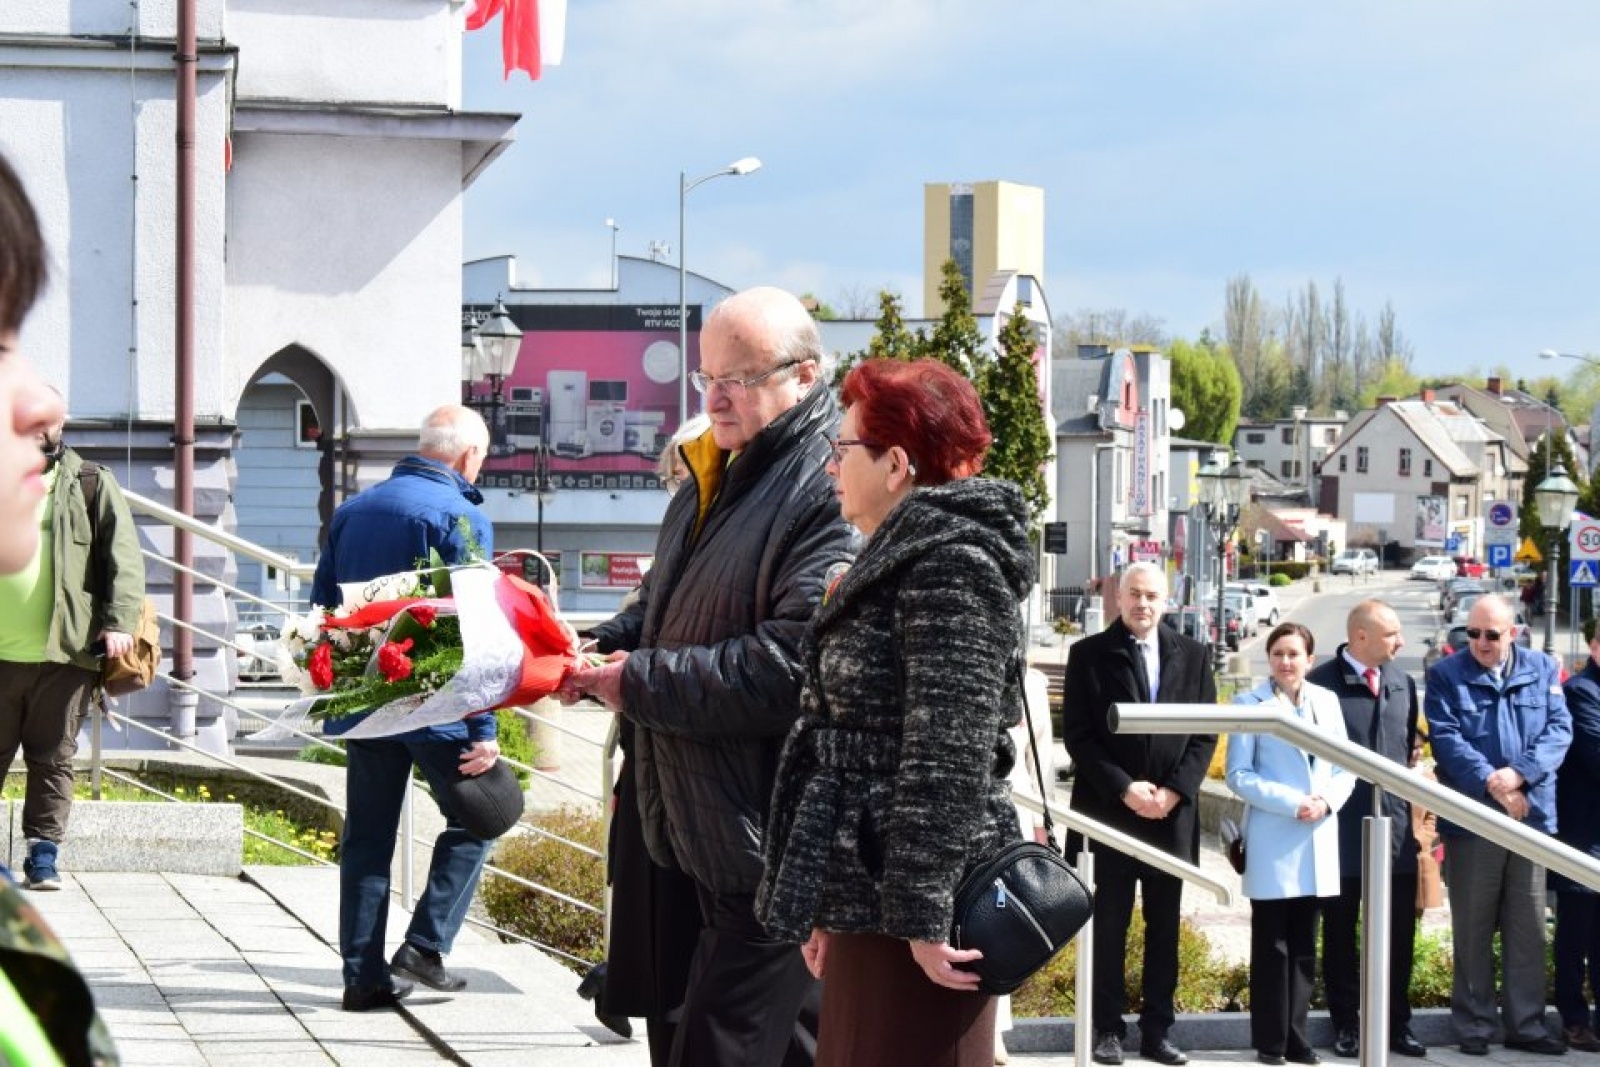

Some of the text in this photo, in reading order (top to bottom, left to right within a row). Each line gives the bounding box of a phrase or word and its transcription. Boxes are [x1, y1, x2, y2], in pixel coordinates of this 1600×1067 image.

[635, 308, 661, 317] Twoje
[1582, 533, 1600, 546] 30
[1495, 547, 1507, 565] P
